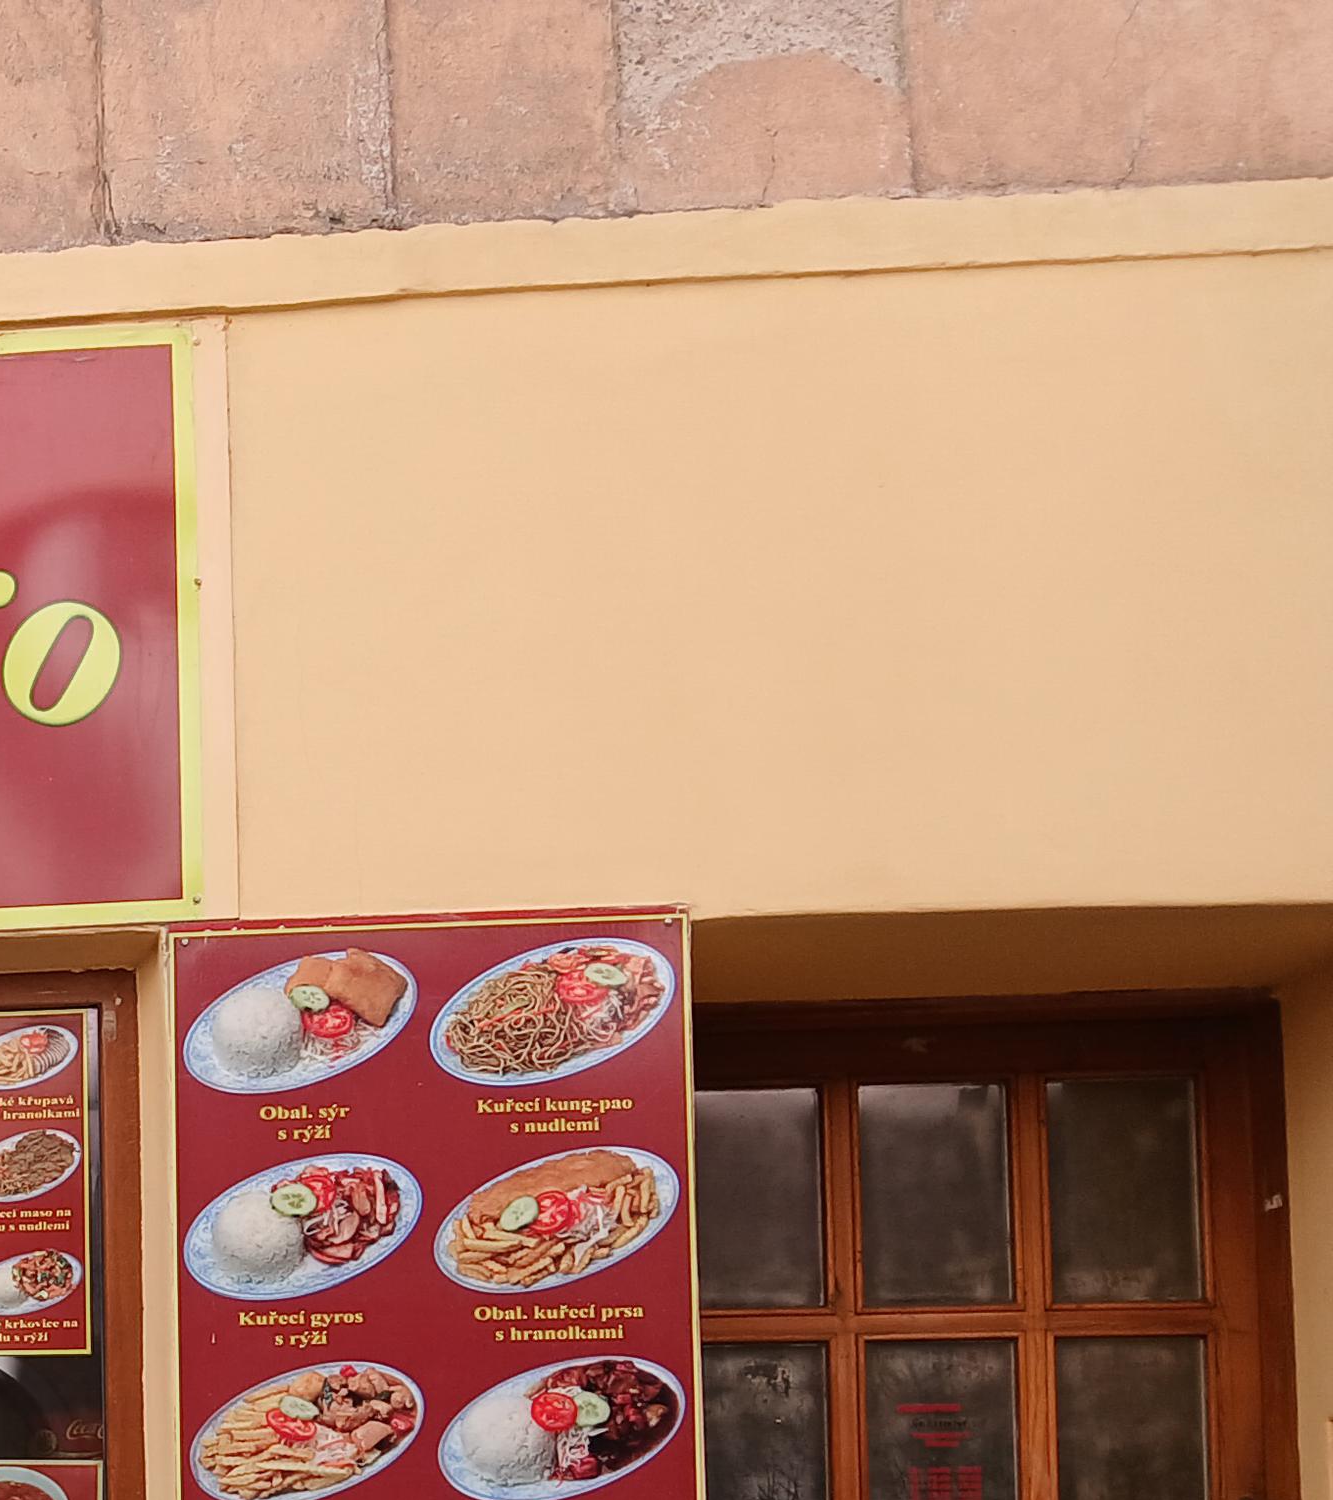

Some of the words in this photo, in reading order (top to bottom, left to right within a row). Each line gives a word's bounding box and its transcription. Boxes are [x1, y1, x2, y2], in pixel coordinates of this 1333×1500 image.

[259, 1105, 313, 1121] Obal.
[318, 1103, 350, 1122] sýr
[477, 1097, 541, 1114] Kuřecí
[545, 1097, 633, 1114] kung-pao
[293, 1124, 331, 1143] rýží
[524, 1116, 600, 1133] nudlemi
[238, 1310, 305, 1326] Kuřecí
[309, 1312, 364, 1328] gyros
[473, 1305, 528, 1321] Obal.
[533, 1303, 596, 1320] kuřecí
[601, 1306, 644, 1322] prsa
[289, 1330, 328, 1349] rýží
[510, 1324, 624, 1341] hranolkami
